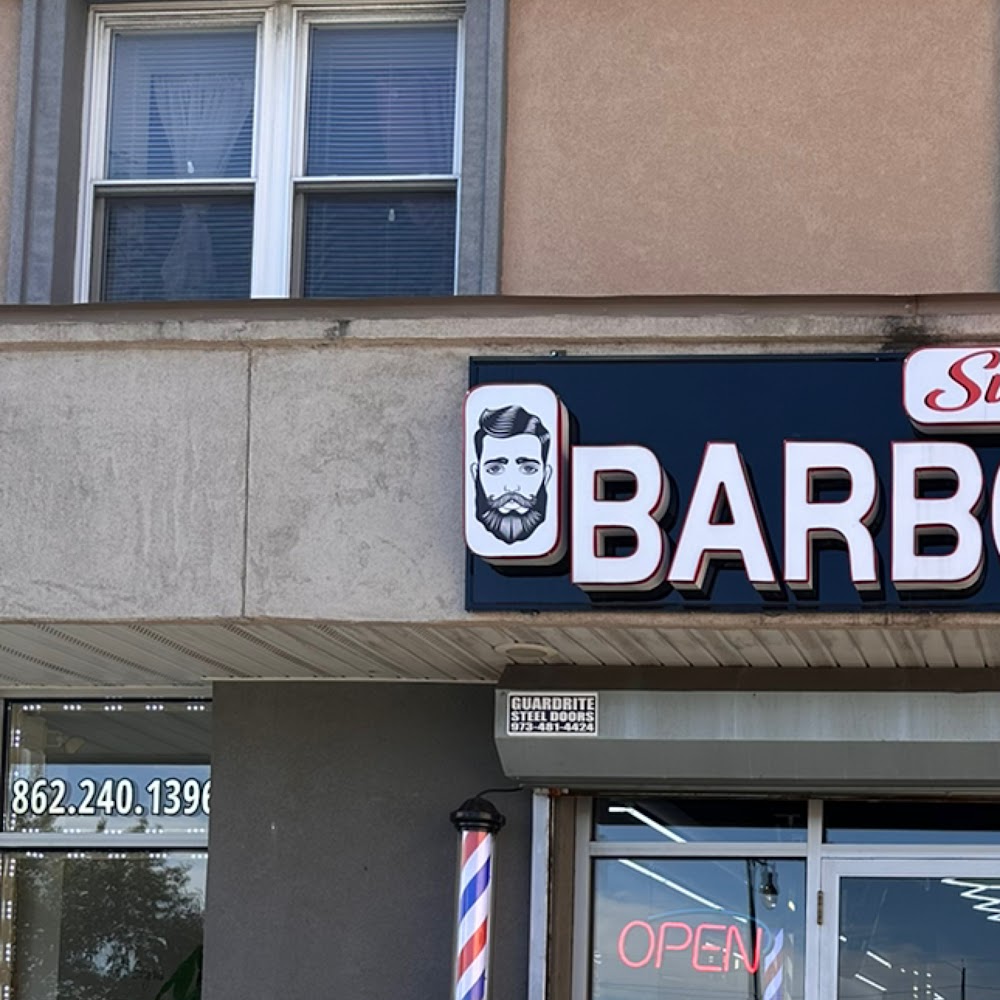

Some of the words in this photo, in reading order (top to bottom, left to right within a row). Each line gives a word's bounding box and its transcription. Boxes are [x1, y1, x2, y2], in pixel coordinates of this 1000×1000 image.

[511, 696, 595, 711] GUARDRITE
[511, 711, 548, 722] STEEL
[549, 711, 595, 722] DOORS
[617, 920, 763, 974] OPEN
